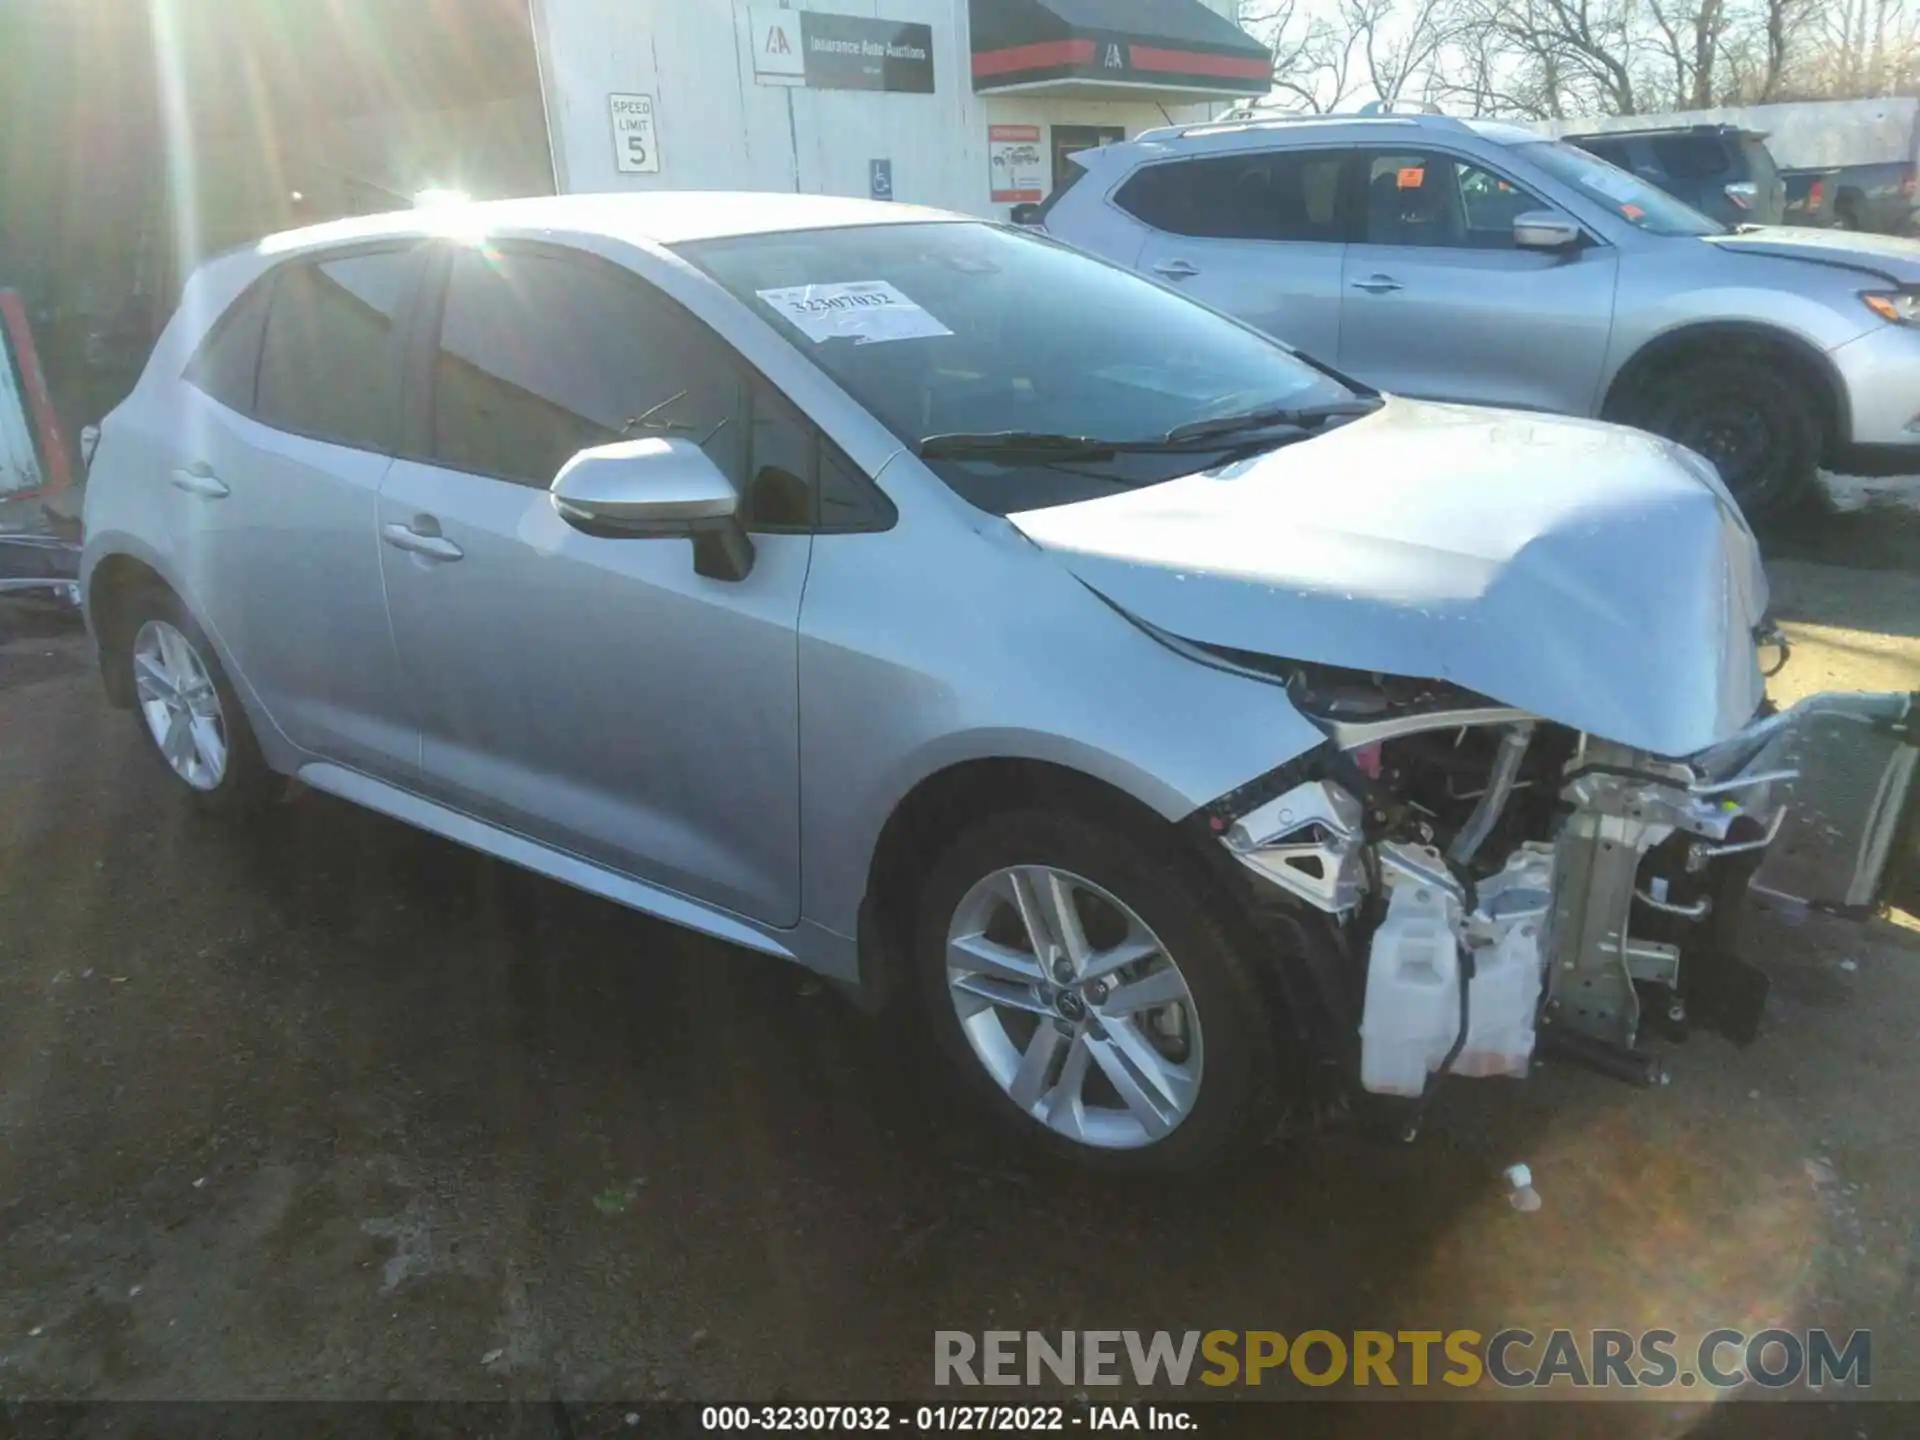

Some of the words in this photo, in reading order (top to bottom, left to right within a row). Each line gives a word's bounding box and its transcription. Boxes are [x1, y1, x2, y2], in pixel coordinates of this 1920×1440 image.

[810, 35, 860, 54] Insurance
[861, 40, 884, 57] Auto
[886, 43, 926, 60] Auctions
[613, 101, 650, 114] SPEED
[619, 119, 648, 131] LIMIT
[628, 136, 646, 165] 5
[789, 292, 894, 313] 32307032
